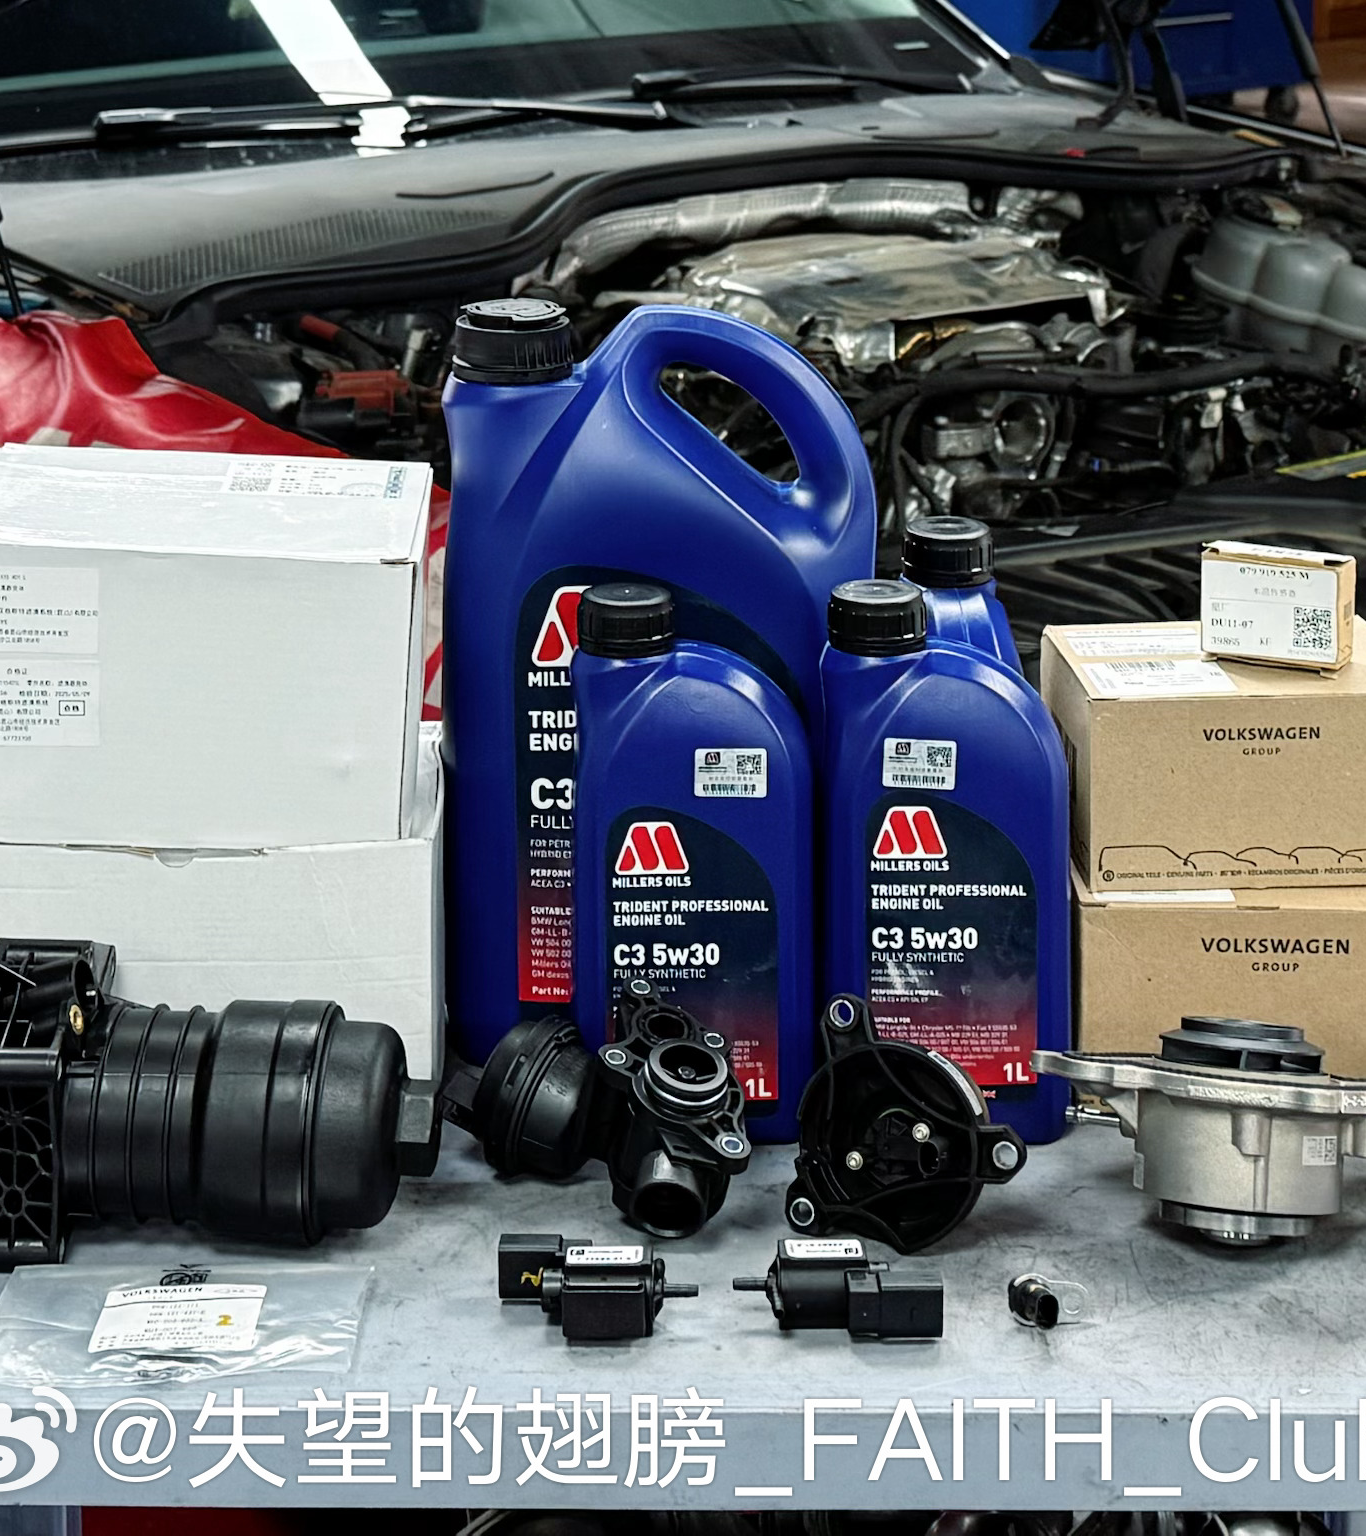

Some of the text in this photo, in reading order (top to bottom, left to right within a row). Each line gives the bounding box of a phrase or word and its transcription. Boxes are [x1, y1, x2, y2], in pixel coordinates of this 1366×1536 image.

[1202, 726, 1321, 742] VOLKSWAGEN
[1242, 747, 1282, 756] GROUP
[530, 777, 575, 811] C3
[870, 860, 950, 872] MILLERS OILS
[612, 876, 692, 889] MILLERS OILS
[870, 884, 1028, 897] TRIDENT PROFESSIONAL
[612, 899, 769, 913] TRIDENT PROFESSIONAL
[871, 897, 945, 910] ENGINE OIL
[612, 914, 686, 927] ENGINE OIL
[871, 926, 979, 950] C3 5w30
[1200, 936, 1350, 955] VOLKSWAGEN
[613, 943, 720, 966] C3 5w30
[871, 951, 965, 963] FULLY SYNTHETIC
[1251, 961, 1300, 972] GROUP
[648, 968, 707, 979] SYNTHETIC
[1002, 1061, 1030, 1083] 1L
[745, 1077, 772, 1098] 1L
